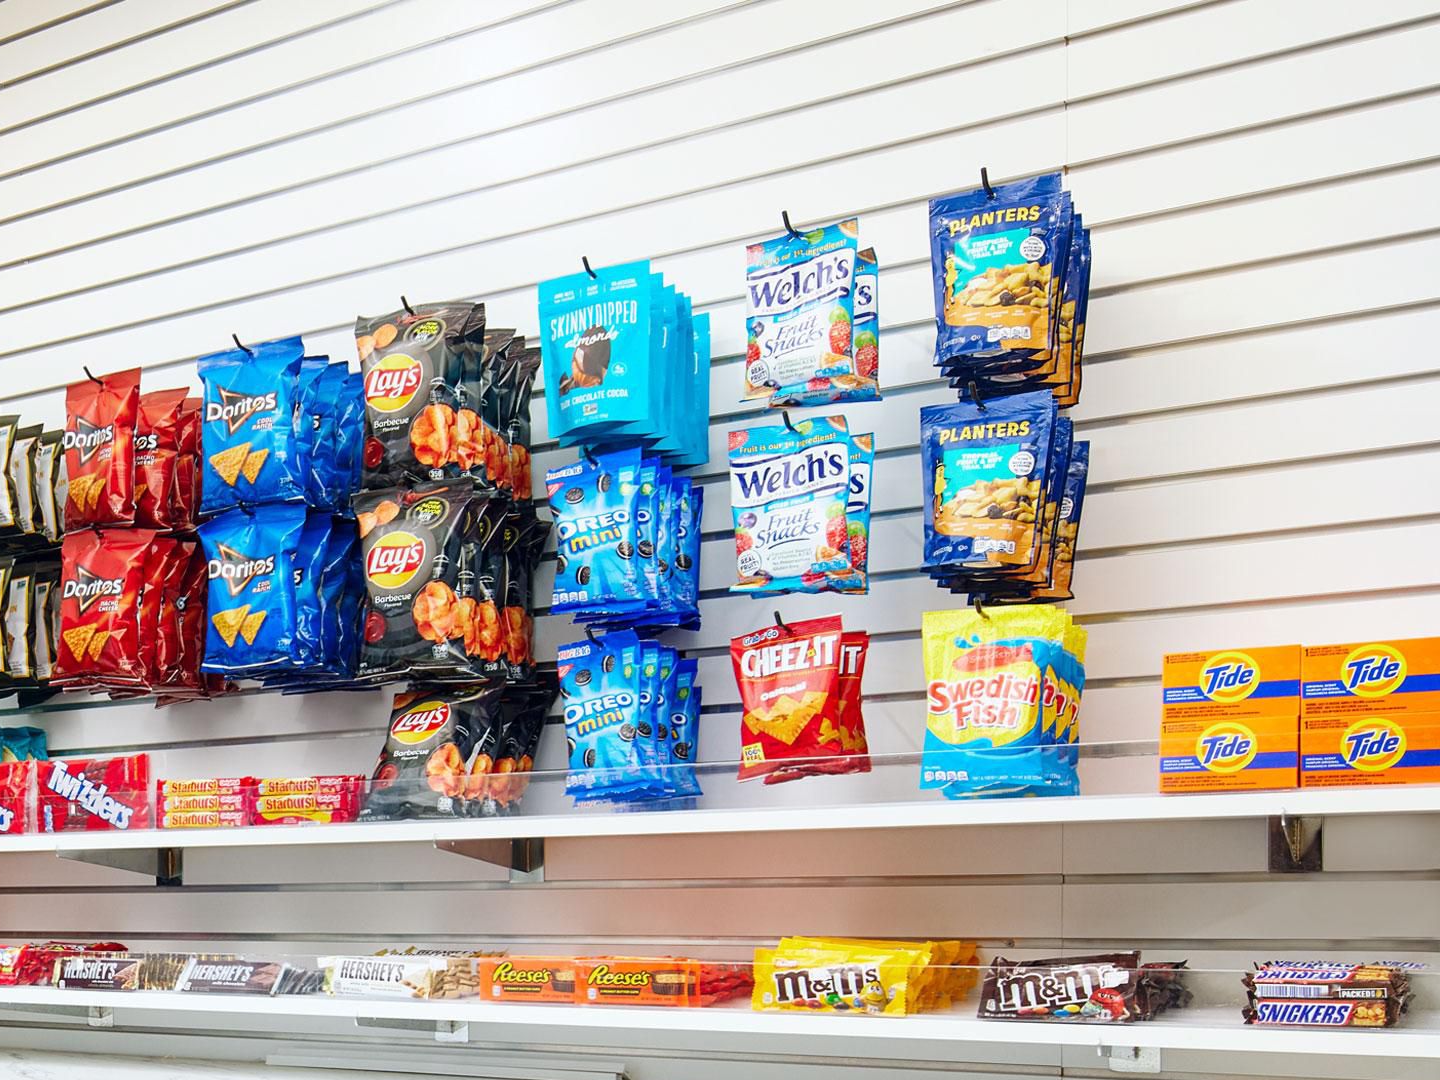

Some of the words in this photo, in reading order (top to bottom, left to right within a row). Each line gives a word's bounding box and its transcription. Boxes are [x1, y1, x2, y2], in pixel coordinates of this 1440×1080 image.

[949, 205, 1041, 238] PLANTERS
[747, 256, 850, 309] Welch's
[550, 299, 638, 342] SKINNYDIPPED
[777, 314, 818, 341] Fruit
[763, 326, 825, 358] Snacks
[367, 366, 420, 399] Lay's
[206, 392, 277, 422] Doritos
[373, 417, 410, 428] Barbecue
[939, 420, 1030, 446] PLANTERS
[64, 424, 113, 450] Doritos
[734, 449, 845, 499] Welch's
[557, 510, 630, 540] OREO
[768, 507, 814, 532] Fruit
[570, 524, 622, 552] mini
[755, 521, 821, 549] Snacks
[209, 556, 275, 580] Doritos
[368, 543, 422, 575] Lay's
[63, 578, 124, 599] Doritos
[374, 593, 412, 604] Barbecue
[1204, 664, 1255, 695] Tide
[1347, 657, 1401, 690] Tide
[928, 674, 1041, 713] Swedish
[395, 704, 448, 733] Lay's
[564, 693, 632, 725] OREO
[577, 708, 624, 736] mini
[954, 700, 1019, 730] Fish
[392, 749, 430, 758] Barbecue
[1201, 735, 1252, 765] Tide
[1346, 730, 1401, 763] Tide
[47, 760, 134, 830] Twizzlers
[63, 960, 118, 979] HERSHEY'S
[191, 965, 254, 982] HERSHEY'S
[340, 959, 405, 983] HERSHEY'S
[492, 961, 552, 983] Reese's
[587, 964, 651, 986] Reese's
[1258, 1003, 1351, 1024] SNICKERS
